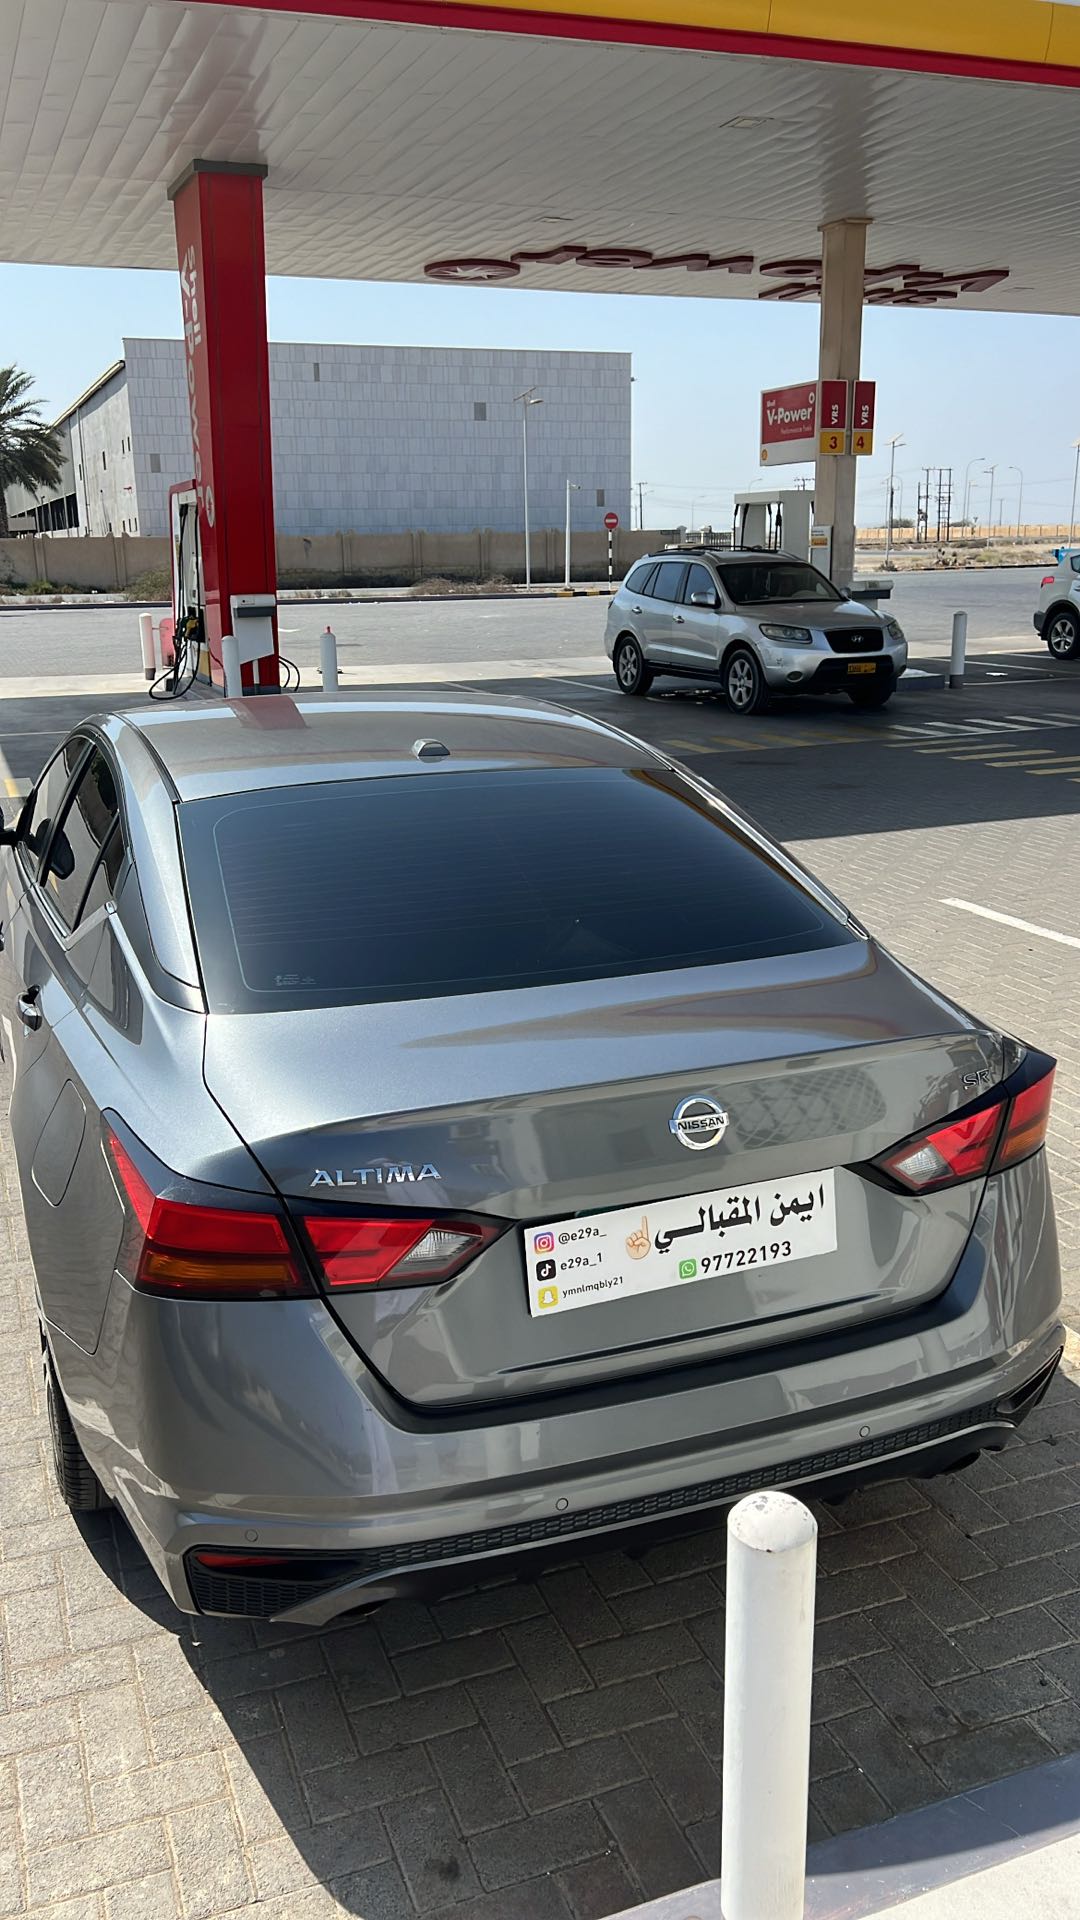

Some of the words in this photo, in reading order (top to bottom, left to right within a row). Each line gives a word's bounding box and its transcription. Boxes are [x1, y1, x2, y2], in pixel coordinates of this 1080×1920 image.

[767, 407, 812, 425] V-Power
[829, 436, 838, 449] 3
[856, 436, 865, 449] 4
[962, 1068, 990, 1090] SR
[677, 1117, 725, 1130] NISSAN
[310, 1163, 442, 1187] ALTIMA
[770, 1184, 825, 1226] ايمن
[558, 1227, 607, 1245] @e29a_
[560, 1252, 602, 1271] e29a_1
[701, 1240, 792, 1274] 97722193
